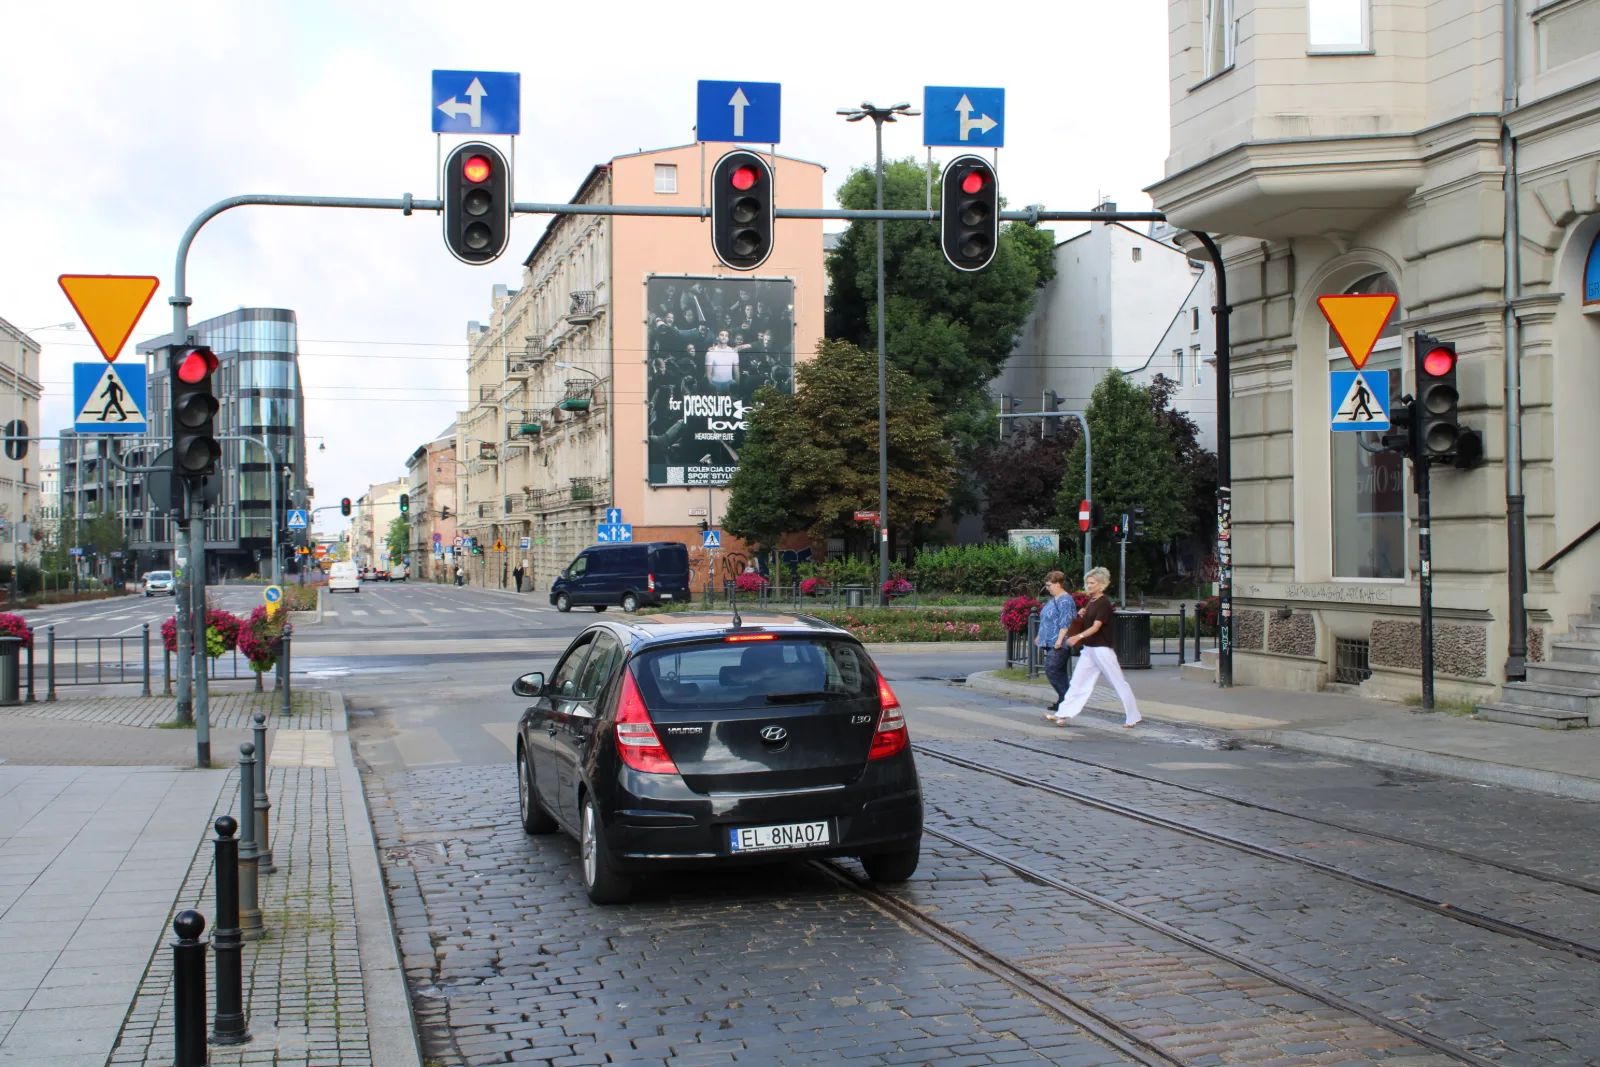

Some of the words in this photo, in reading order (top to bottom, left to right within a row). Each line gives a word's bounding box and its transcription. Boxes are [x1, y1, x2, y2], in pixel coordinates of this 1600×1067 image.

[669, 397, 682, 410] for
[683, 395, 732, 424] pressure
[707, 417, 750, 430] love
[667, 727, 703, 735] HYUNDAI
[742, 829, 765, 848] EL
[771, 824, 825, 845] 8NA07
